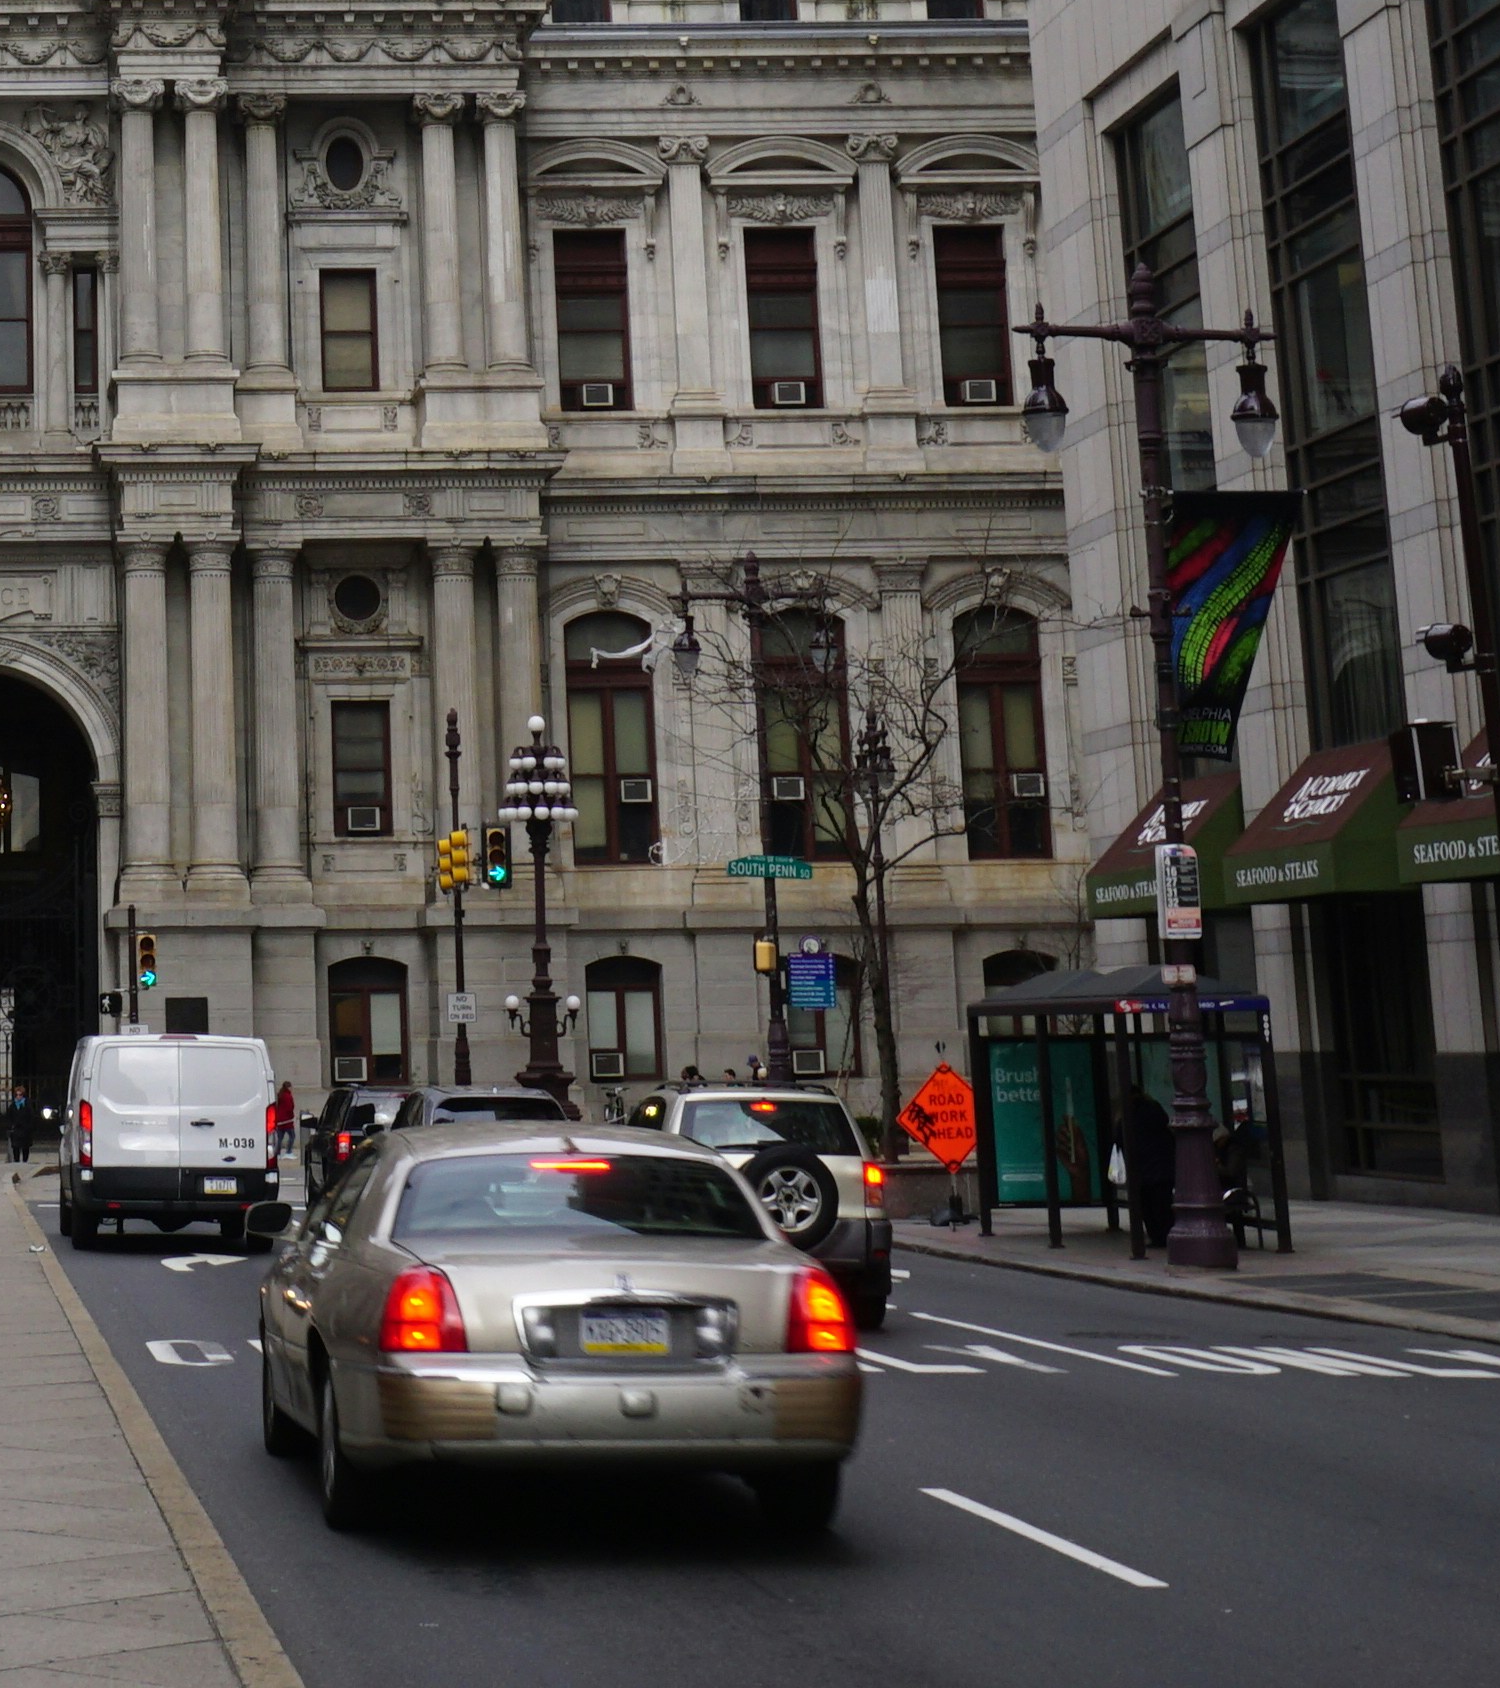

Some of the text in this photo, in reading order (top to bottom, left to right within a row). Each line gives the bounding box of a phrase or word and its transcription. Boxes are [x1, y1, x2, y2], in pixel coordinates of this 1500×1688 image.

[1413, 840, 1467, 864] SEAFOOD
[1468, 843, 1477, 858] &
[730, 862, 810, 878] SOUTH PENN SQ
[1235, 859, 1319, 888] SEAFOOD & STEAKS
[1095, 884, 1129, 904] SEAFOOD
[1135, 879, 1158, 897] STEA
[929, 1093, 965, 1106] ROAD
[996, 1085, 1041, 1103] bette
[218, 1138, 255, 1149] M-038
